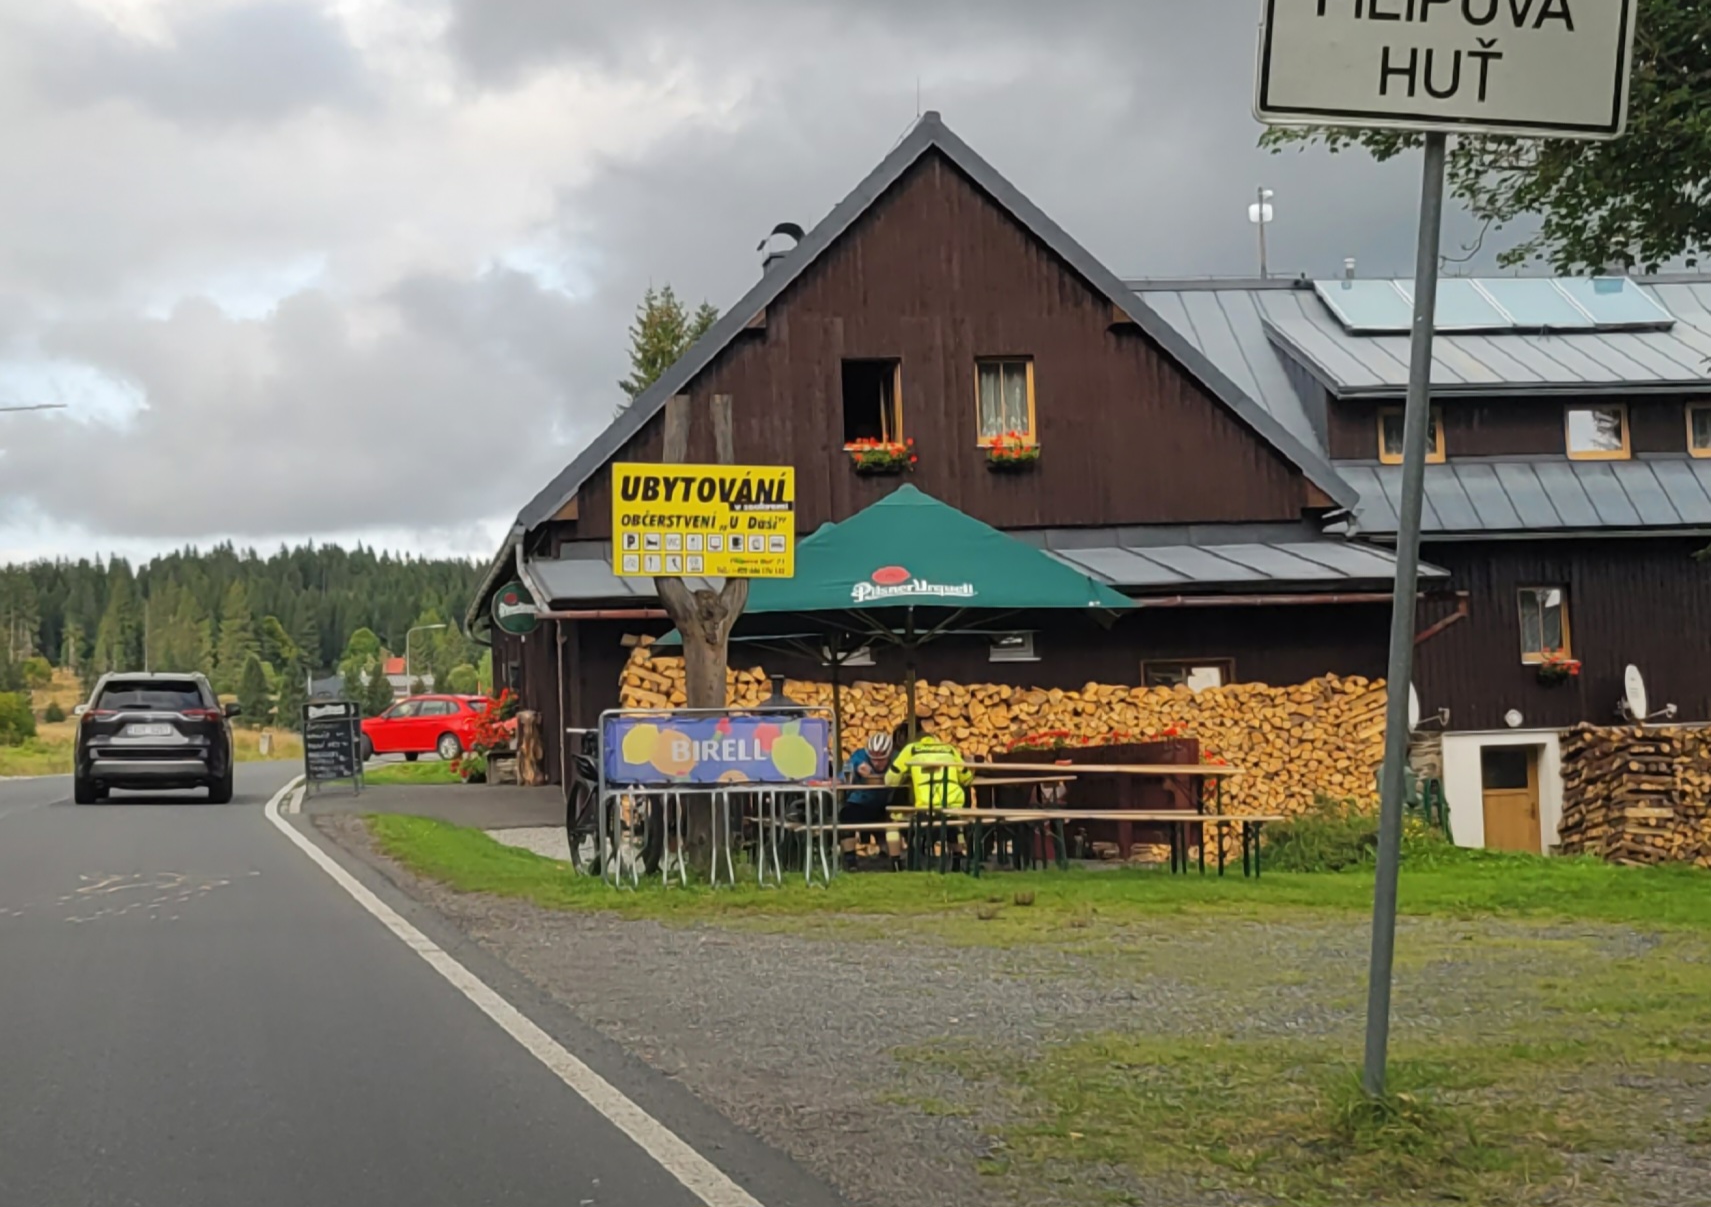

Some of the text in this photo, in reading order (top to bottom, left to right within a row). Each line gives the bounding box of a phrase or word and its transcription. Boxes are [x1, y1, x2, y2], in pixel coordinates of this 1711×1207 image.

[1379, 37, 1503, 103] HUŤ
[621, 471, 787, 503] UBYTOVÁNÍ
[621, 511, 717, 529] OBČERSTVENÍ
[626, 535, 636, 549] P
[850, 578, 978, 602] Pilsner Urquell
[671, 738, 768, 762] BIRELL
